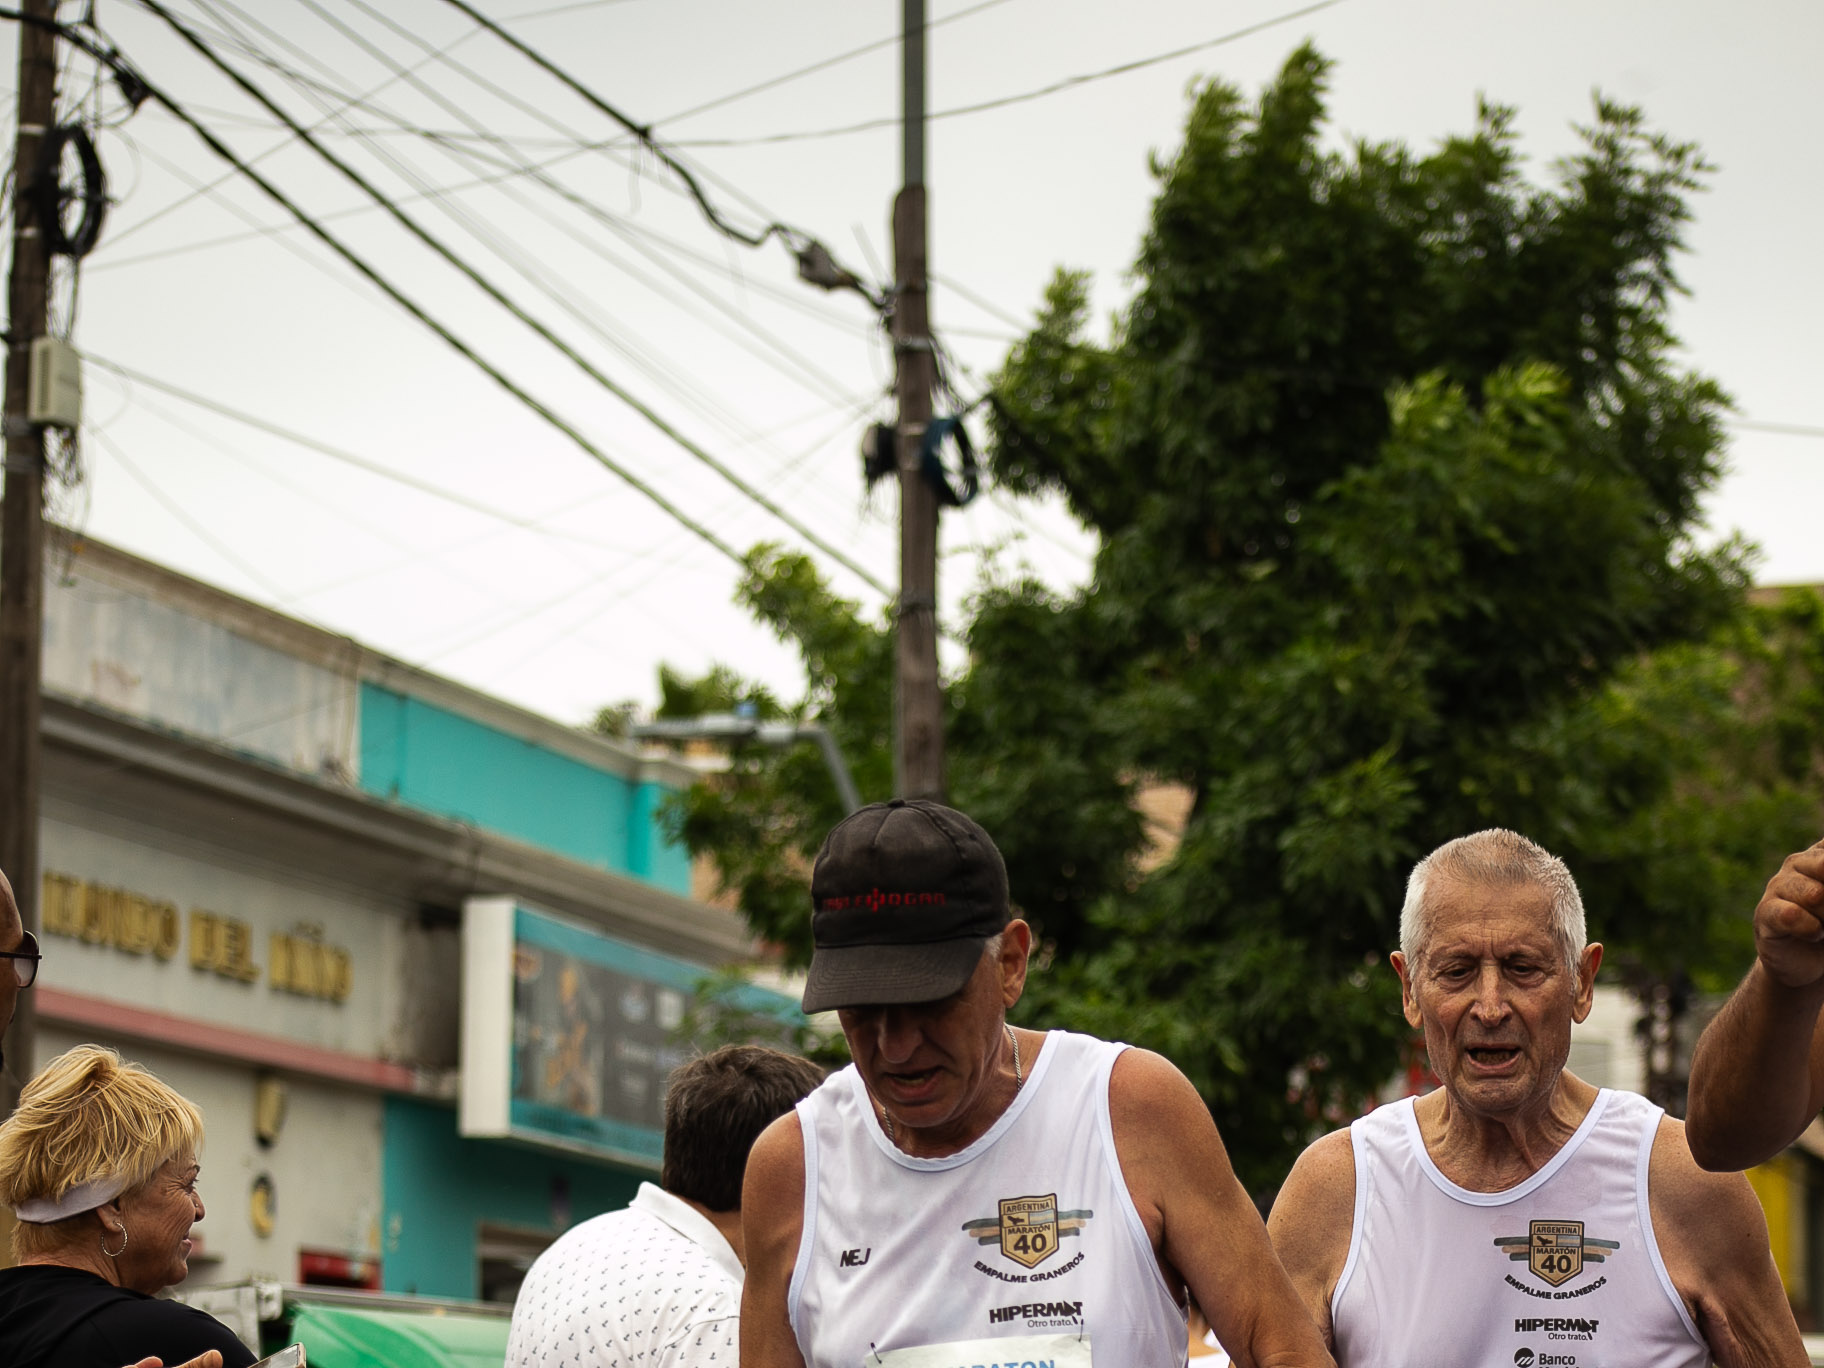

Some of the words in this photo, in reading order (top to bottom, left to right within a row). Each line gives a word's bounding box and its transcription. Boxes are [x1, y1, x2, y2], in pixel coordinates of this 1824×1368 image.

[188, 905, 260, 985] DEL
[1006, 1201, 1050, 1213] ARGENTINA
[1007, 1223, 1051, 1235] MARATÓN
[1536, 1226, 1577, 1234] ARGENTINA
[1013, 1233, 1047, 1255] 40
[1536, 1247, 1577, 1255] MARATÓN
[840, 1248, 871, 1267] NEJ
[1540, 1255, 1572, 1274] 40
[973, 1260, 1028, 1283] EMPALME
[1029, 1252, 1085, 1282] GRANEROS
[1504, 1274, 1551, 1300] EMPALME
[1553, 1276, 1607, 1300] GRANEROS
[989, 1300, 1083, 1324] HIPERMAT
[1027, 1318, 1048, 1328] Otro
[1514, 1318, 1599, 1333] HIPERMAT
[1548, 1332, 1566, 1340] Otro
[1538, 1353, 1576, 1366] Banco
